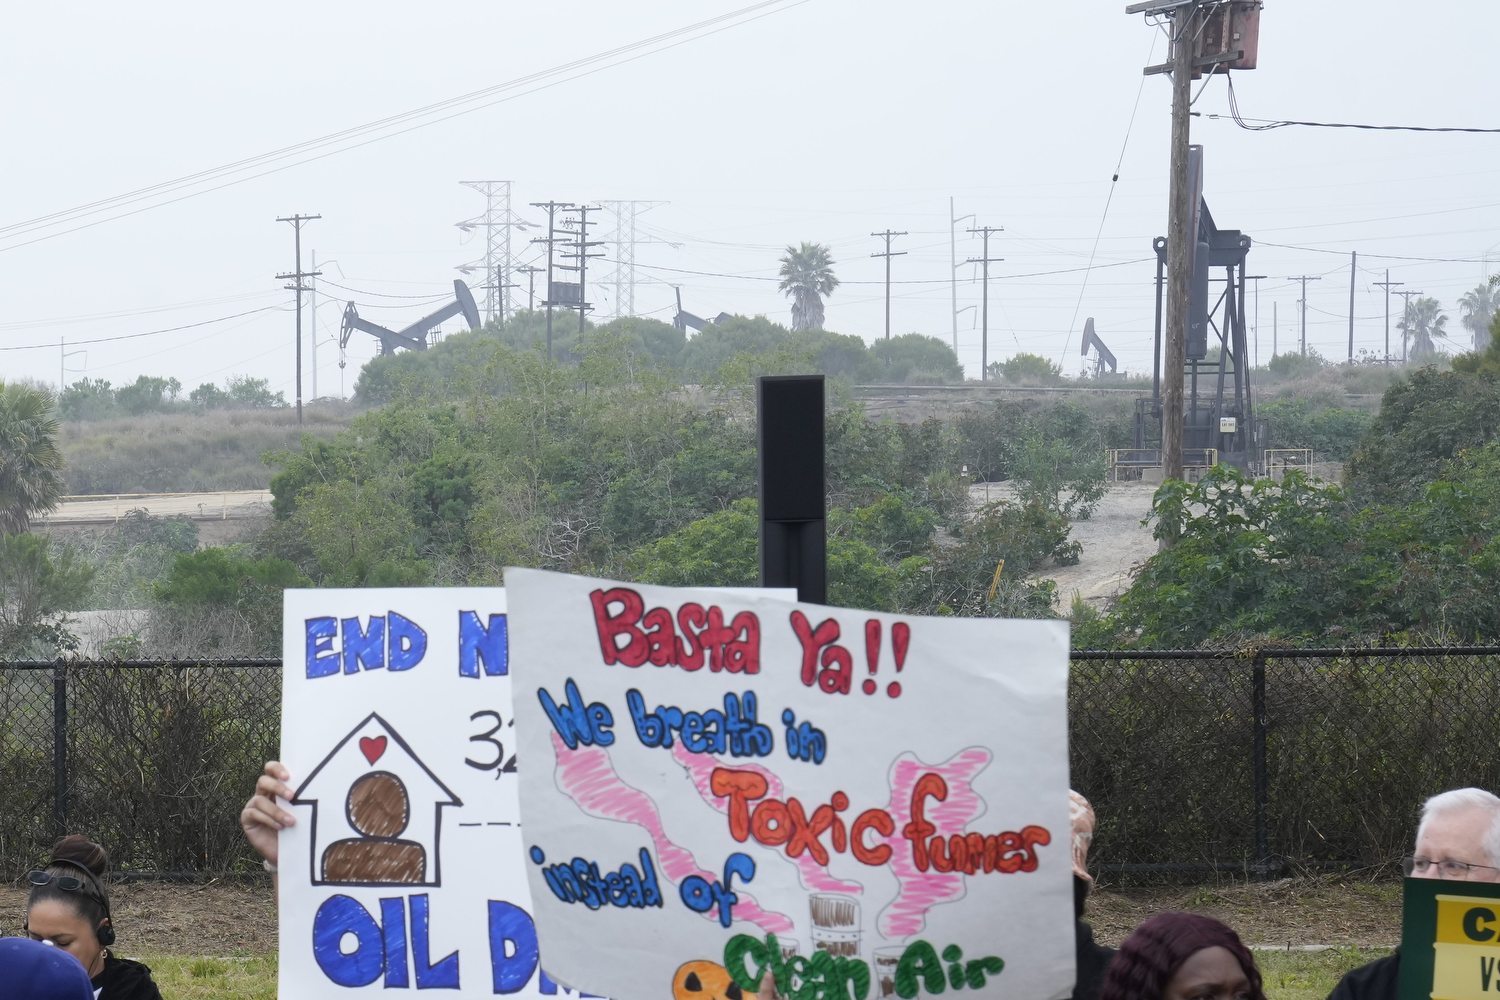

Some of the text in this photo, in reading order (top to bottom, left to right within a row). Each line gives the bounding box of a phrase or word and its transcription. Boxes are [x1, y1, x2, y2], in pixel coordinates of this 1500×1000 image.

[304, 609, 428, 680] END
[589, 587, 761, 675] Basta
[789, 609, 911, 699] Ya!!
[537, 678, 616, 751] We
[626, 687, 774, 758] breath
[781, 707, 827, 765] in
[901, 772, 1052, 876] fumes
[529, 844, 756, 928] instead of
[311, 892, 461, 990] OIL
[894, 939, 1006, 1000] Air
